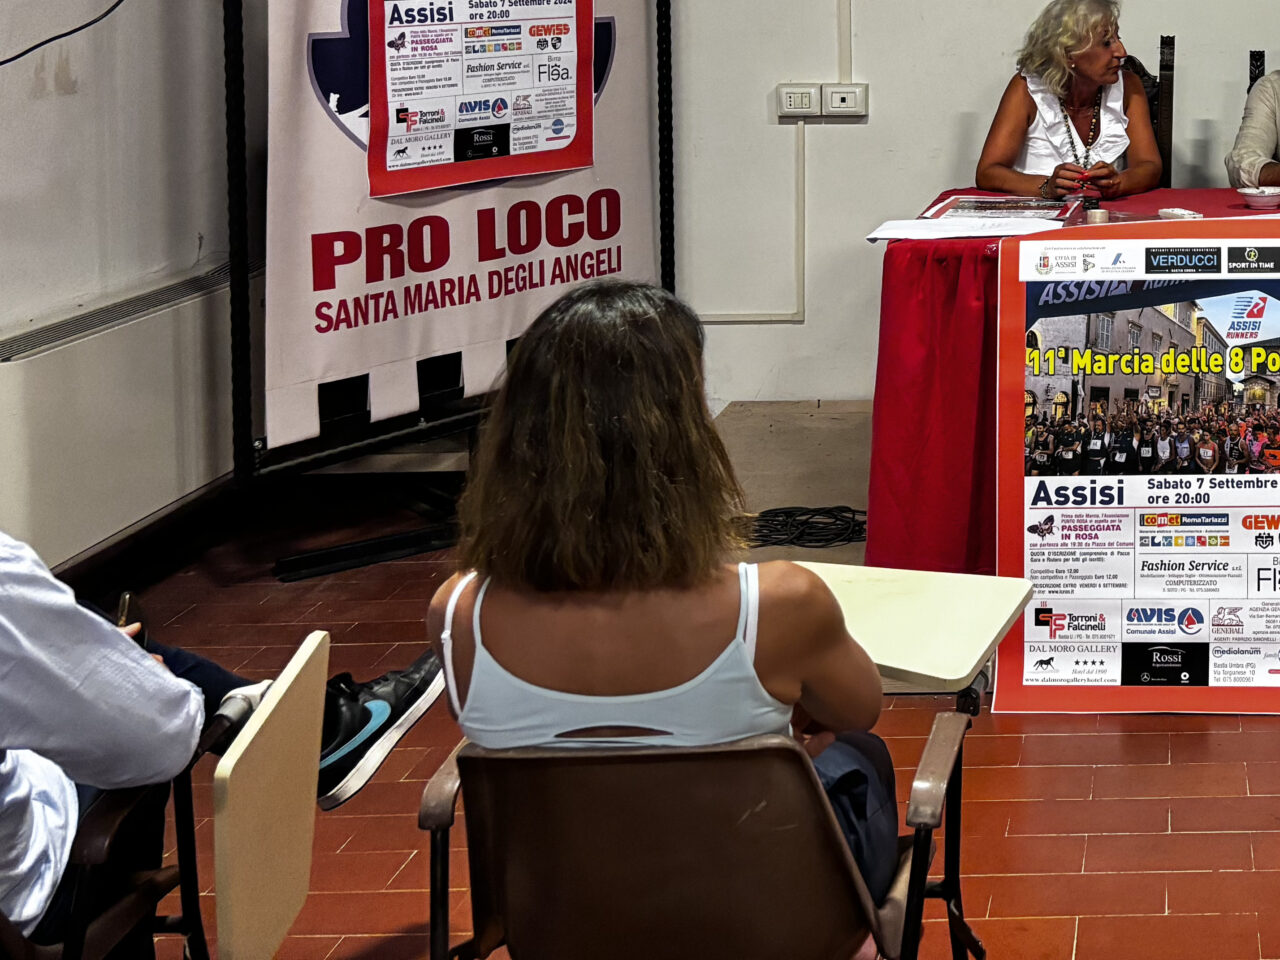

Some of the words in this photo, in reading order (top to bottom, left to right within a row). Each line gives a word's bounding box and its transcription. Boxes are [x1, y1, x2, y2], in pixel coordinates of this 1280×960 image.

[388, 1, 453, 25] Assisi
[487, 10, 509, 19] 20:00
[466, 62, 495, 73] Fashion
[497, 60, 522, 70] Service
[458, 99, 491, 114] AVIS
[311, 216, 450, 292] PRO
[477, 188, 622, 262] LOCO
[1150, 255, 1216, 266] VERDUCCI
[314, 290, 399, 334] SANTA
[404, 274, 480, 316] MARIA
[488, 260, 545, 300] DEGLI
[550, 246, 622, 286] ANGELI
[1228, 321, 1261, 330] ASSISI
[1072, 347, 1155, 376] Marcia
[1161, 346, 1223, 374] delle
[1229, 348, 1244, 373] 8
[1148, 478, 1192, 490] Sabato
[1196, 478, 1204, 489] 7
[1208, 478, 1278, 489] Settembre
[1031, 480, 1124, 506] Assisi
[1148, 496, 1168, 504] ore
[1175, 494, 1210, 504] 20:00
[1141, 560, 1185, 571] Fashion
[1188, 560, 1228, 571] Service
[1068, 614, 1097, 622] Torroni
[1126, 608, 1176, 622] AVIS
[1068, 622, 1106, 631] Falcinelli
[1153, 651, 1182, 662] Rossi
